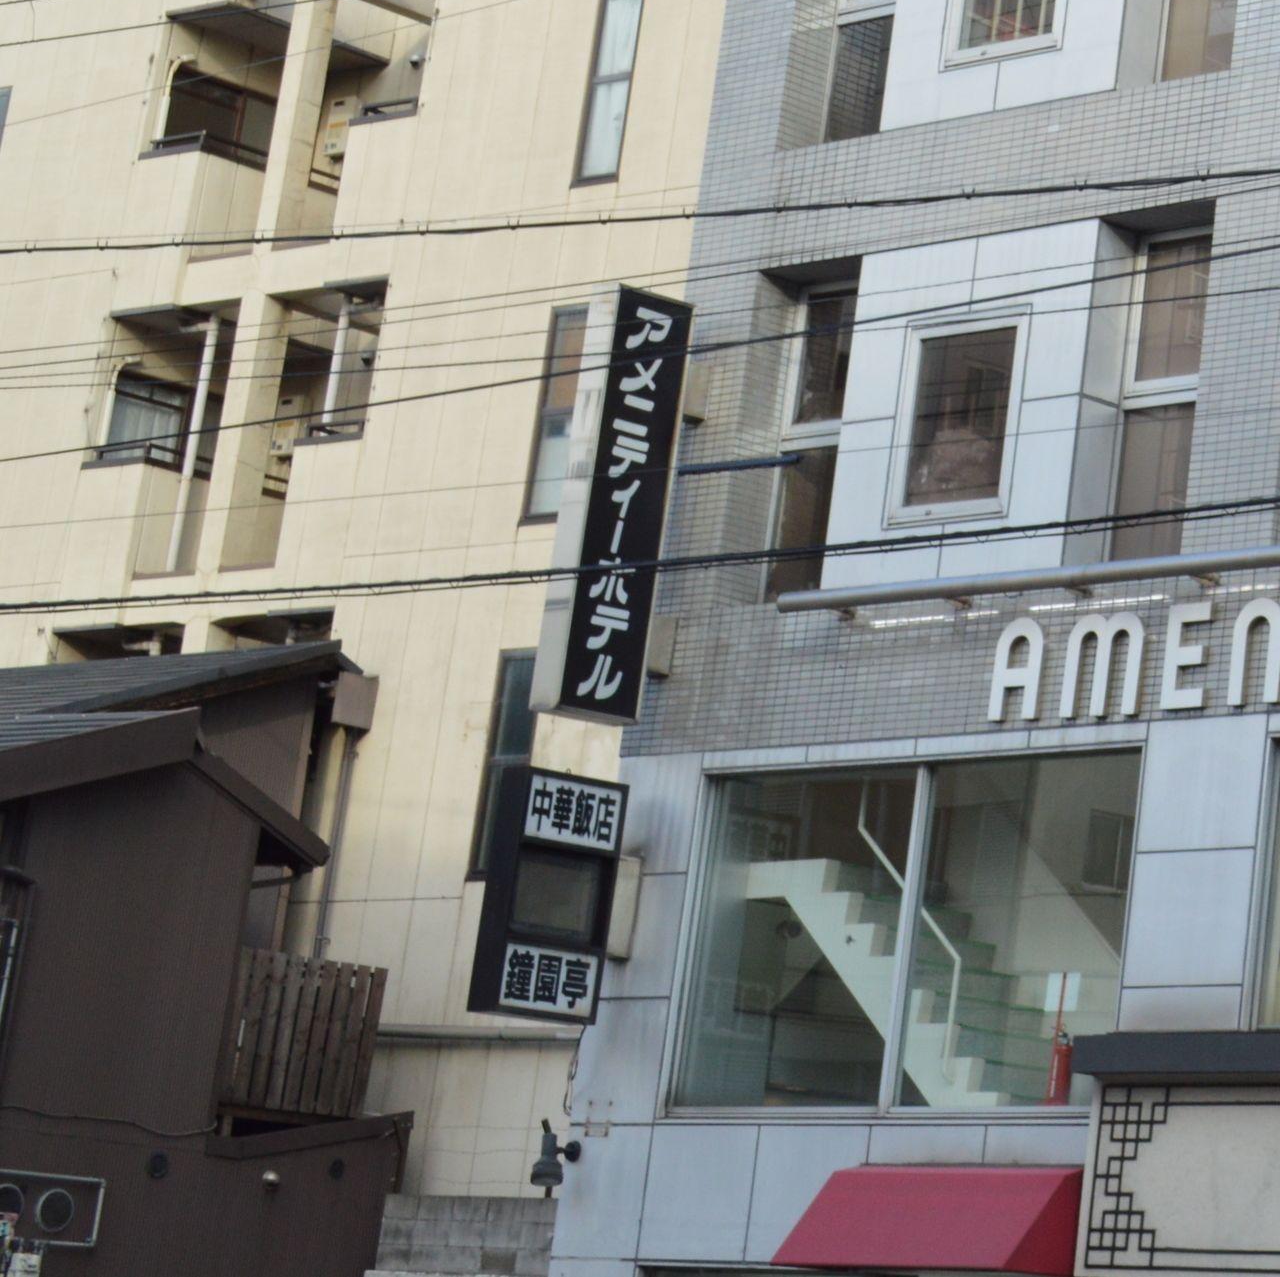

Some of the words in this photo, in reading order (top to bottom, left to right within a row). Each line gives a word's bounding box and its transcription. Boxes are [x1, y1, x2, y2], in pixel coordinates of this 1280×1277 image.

[576, 306, 673, 700] アメニティーホテル
[531, 782, 617, 843] 中華飯店
[504, 949, 591, 1009] 鐘園亭
